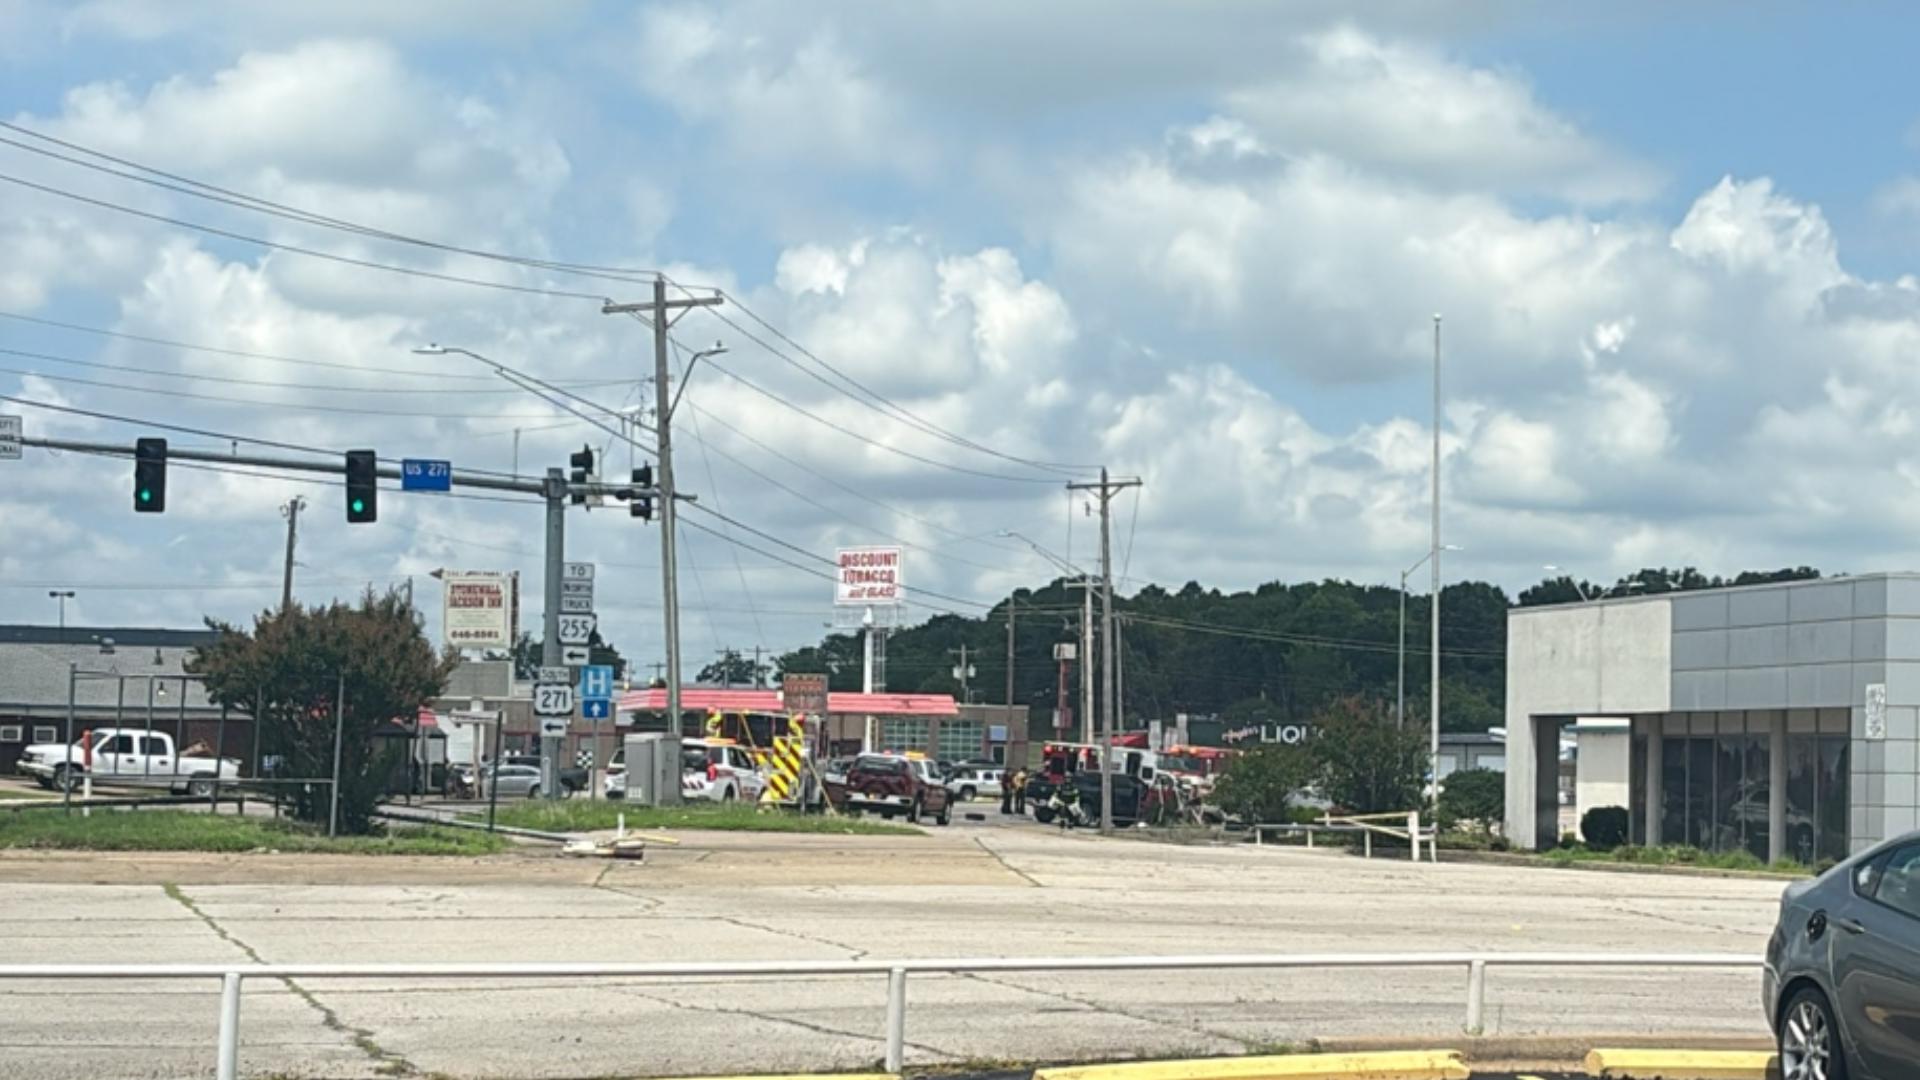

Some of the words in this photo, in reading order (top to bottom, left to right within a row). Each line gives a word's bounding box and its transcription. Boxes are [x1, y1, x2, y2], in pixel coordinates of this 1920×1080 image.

[405, 463, 422, 476] US
[428, 463, 447, 477] 271
[841, 552, 897, 567] DISCOUNT
[570, 566, 586, 576] TO
[843, 569, 895, 584] TOBACCO
[564, 599, 591, 609] TRUCK
[560, 618, 589, 638] 255
[541, 669, 568, 680] SOUTH
[587, 670, 607, 696] H
[541, 689, 567, 709] 271
